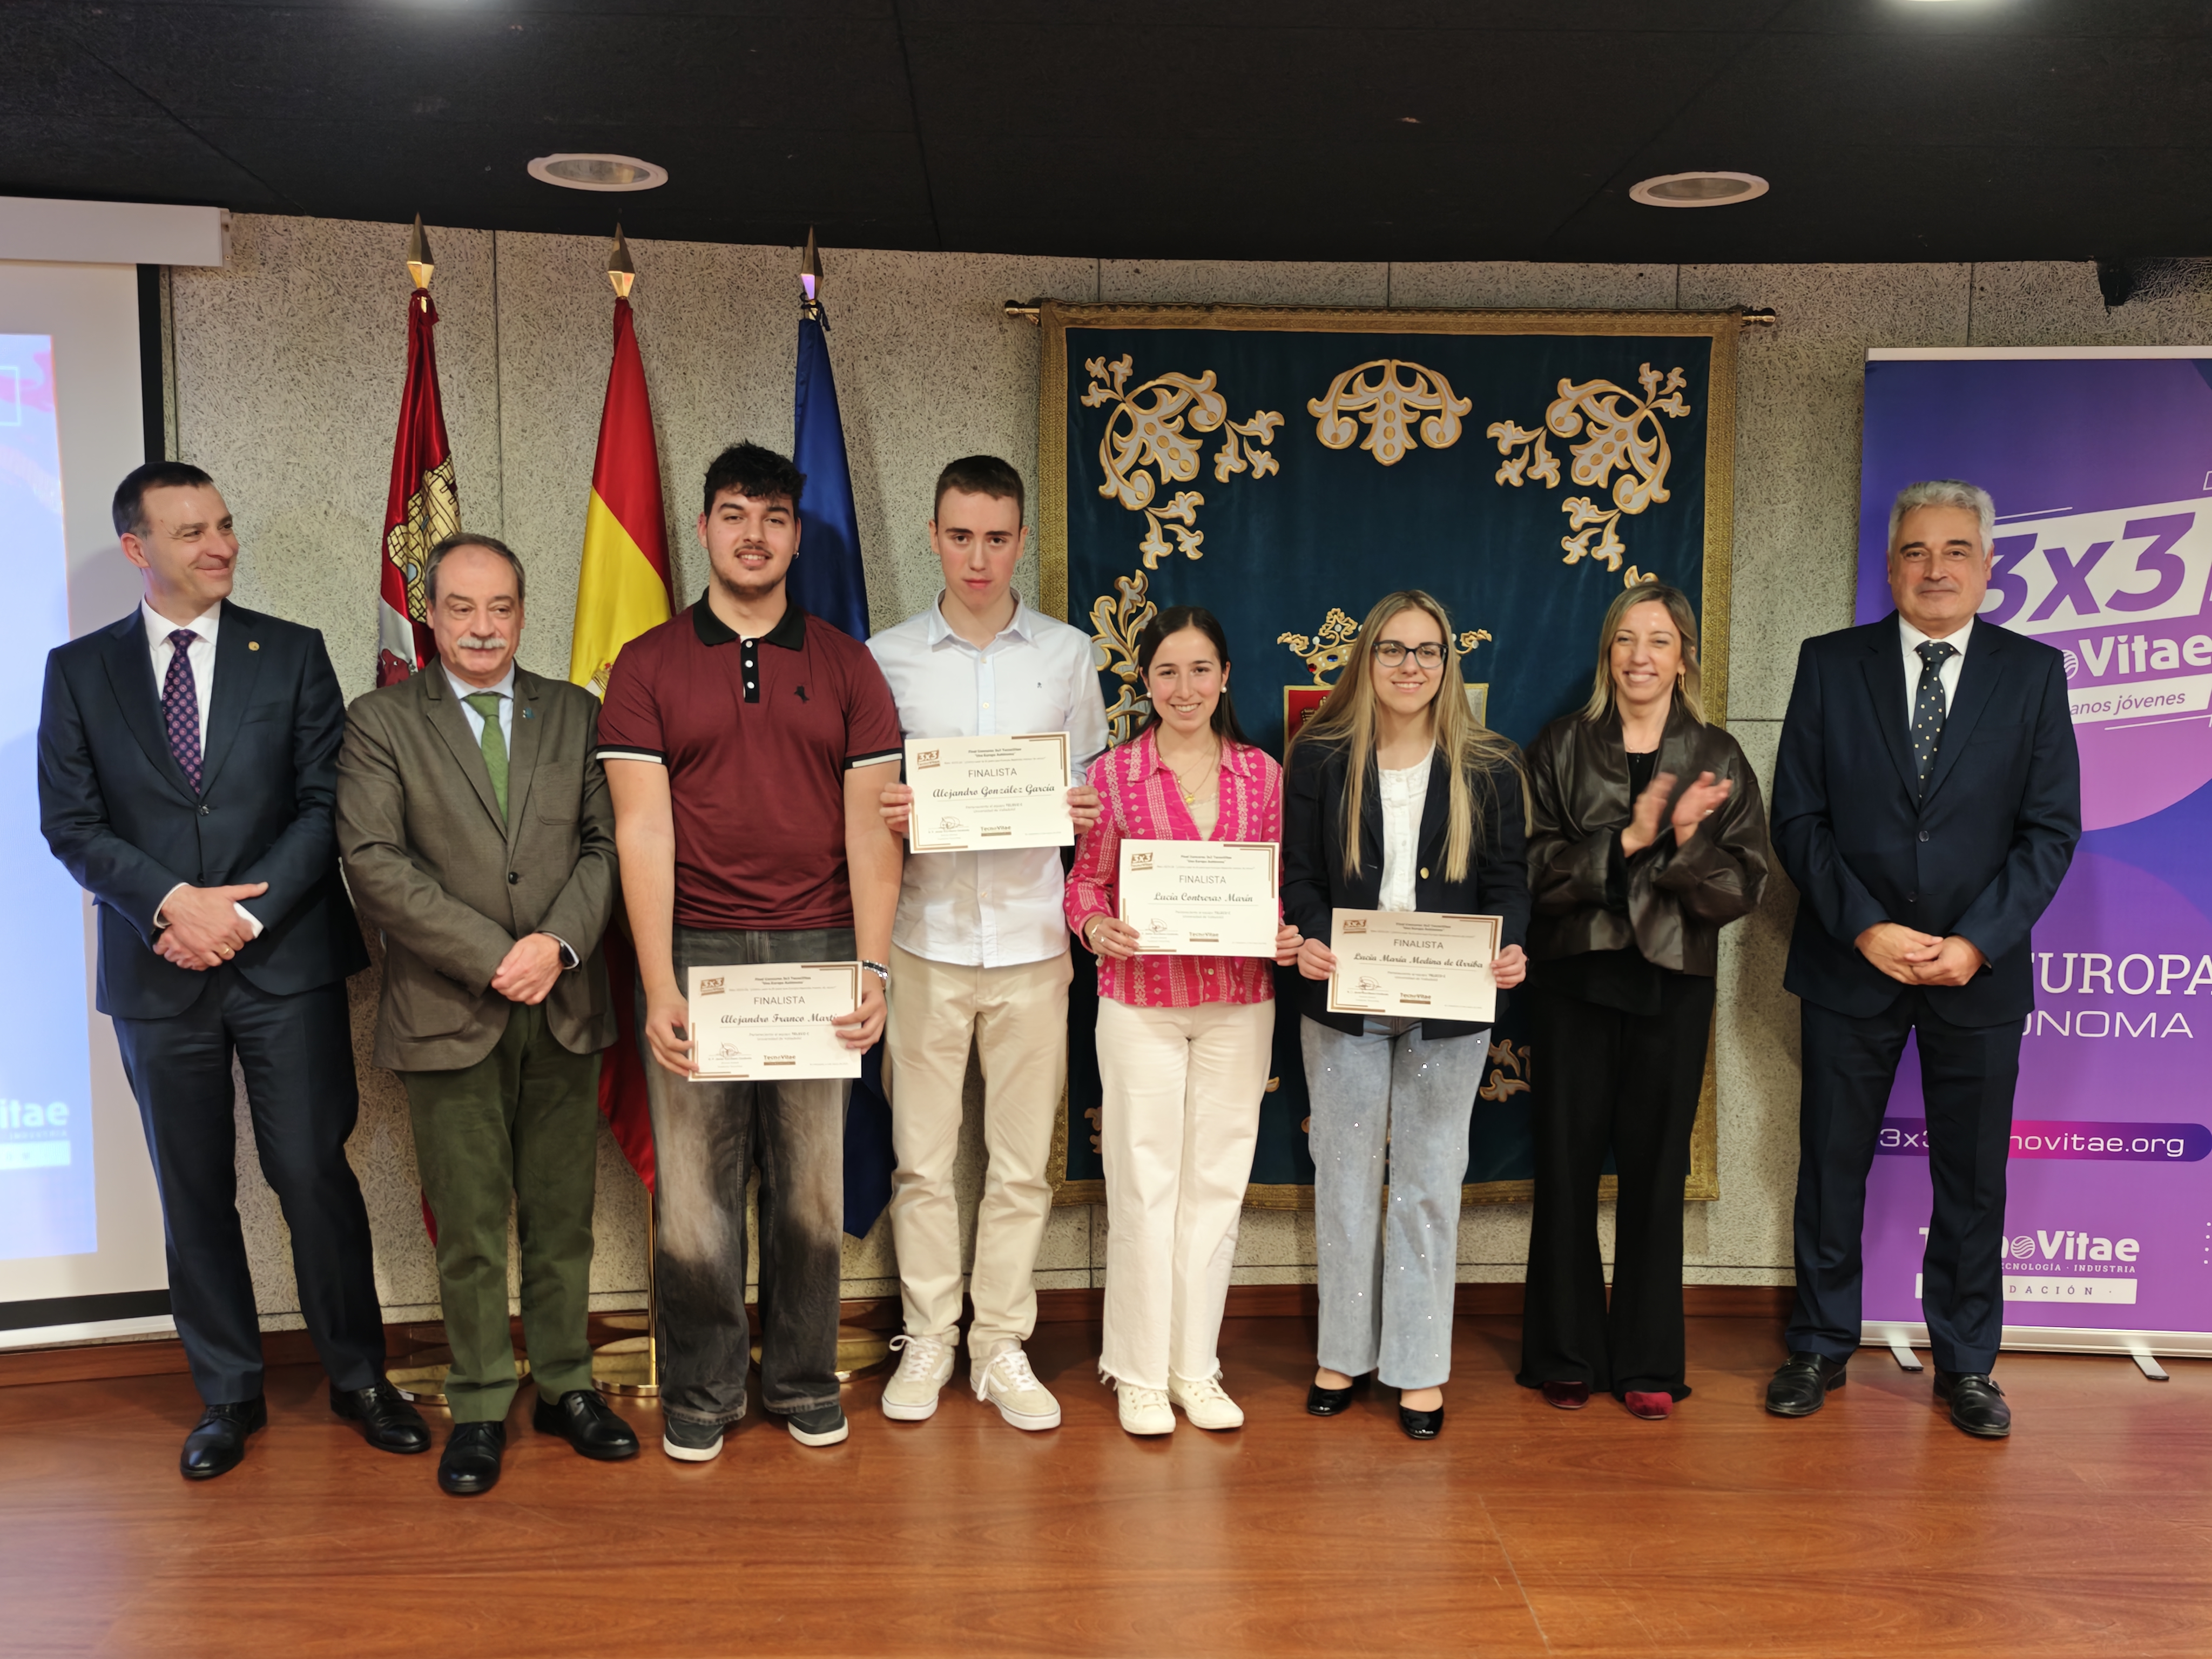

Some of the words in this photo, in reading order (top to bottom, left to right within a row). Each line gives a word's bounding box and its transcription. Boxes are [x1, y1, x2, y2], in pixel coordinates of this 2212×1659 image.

[1977, 512, 2196, 625] 3x3
[2070, 700, 2111, 716] anos
[2113, 693, 2186, 716] jóvenes
[968, 767, 1017, 778] FINALISTA
[933, 787, 978, 799] Alejandro
[981, 785, 1023, 797] González
[1026, 784, 1055, 795] García
[1179, 875, 1226, 884] FINALISTA
[1181, 892, 1222, 902] Contreras
[1393, 939, 1444, 949] FINALISTA
[1379, 954, 1406, 963] María
[1409, 956, 1441, 966] Medina
[1456, 959, 1483, 968] Arriba
[2032, 952, 2212, 995] UROPA
[754, 996, 805, 1005] FINALISTA
[721, 1014, 769, 1026] Alejandro
[772, 1014, 805, 1023] Franco
[807, 1013, 837, 1022] Martí
[0, 1098, 70, 1128] itae
[2074, 1264, 2136, 1273] INDUSTRIA
[2009, 1284, 2093, 1296] DACIÓN
